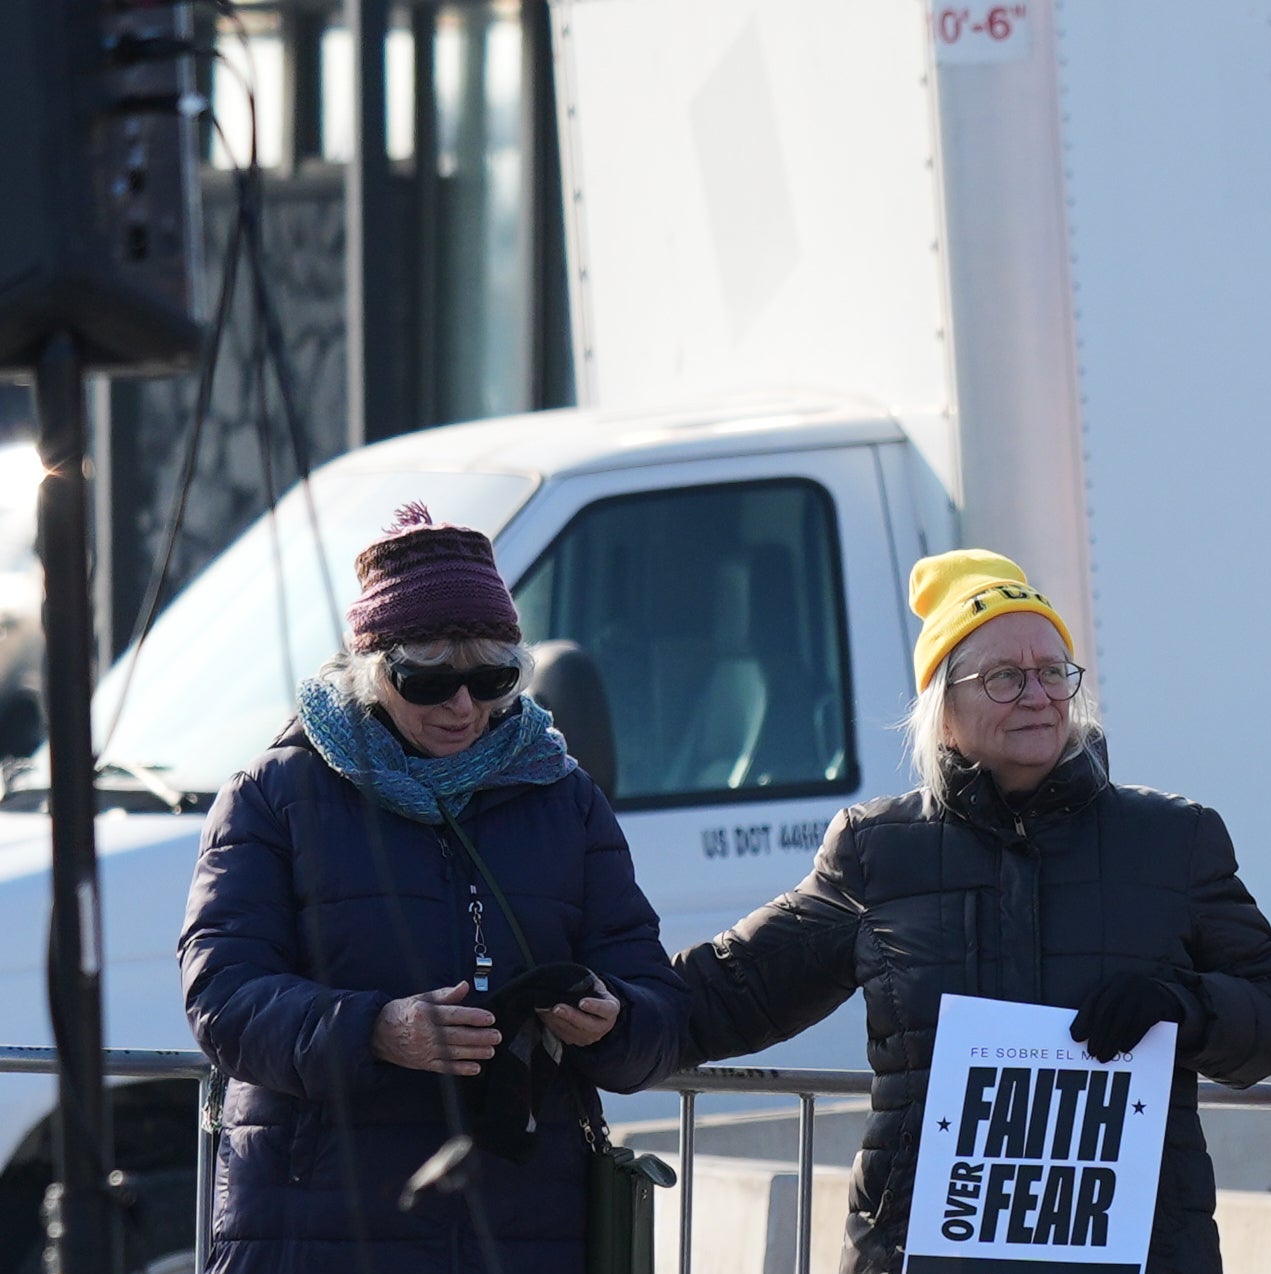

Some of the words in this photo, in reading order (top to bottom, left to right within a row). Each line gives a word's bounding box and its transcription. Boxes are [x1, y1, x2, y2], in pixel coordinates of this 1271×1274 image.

[701, 826, 729, 859] US
[734, 824, 771, 857] DOT
[970, 1047, 989, 1058] FE
[996, 1047, 1049, 1060] SOBRE
[1056, 1049, 1073, 1061] EL
[1081, 1049, 1134, 1063] MDO
[955, 1066, 1132, 1163] FAITH
[941, 1160, 986, 1242] OVER
[977, 1163, 1117, 1247] FEAR
